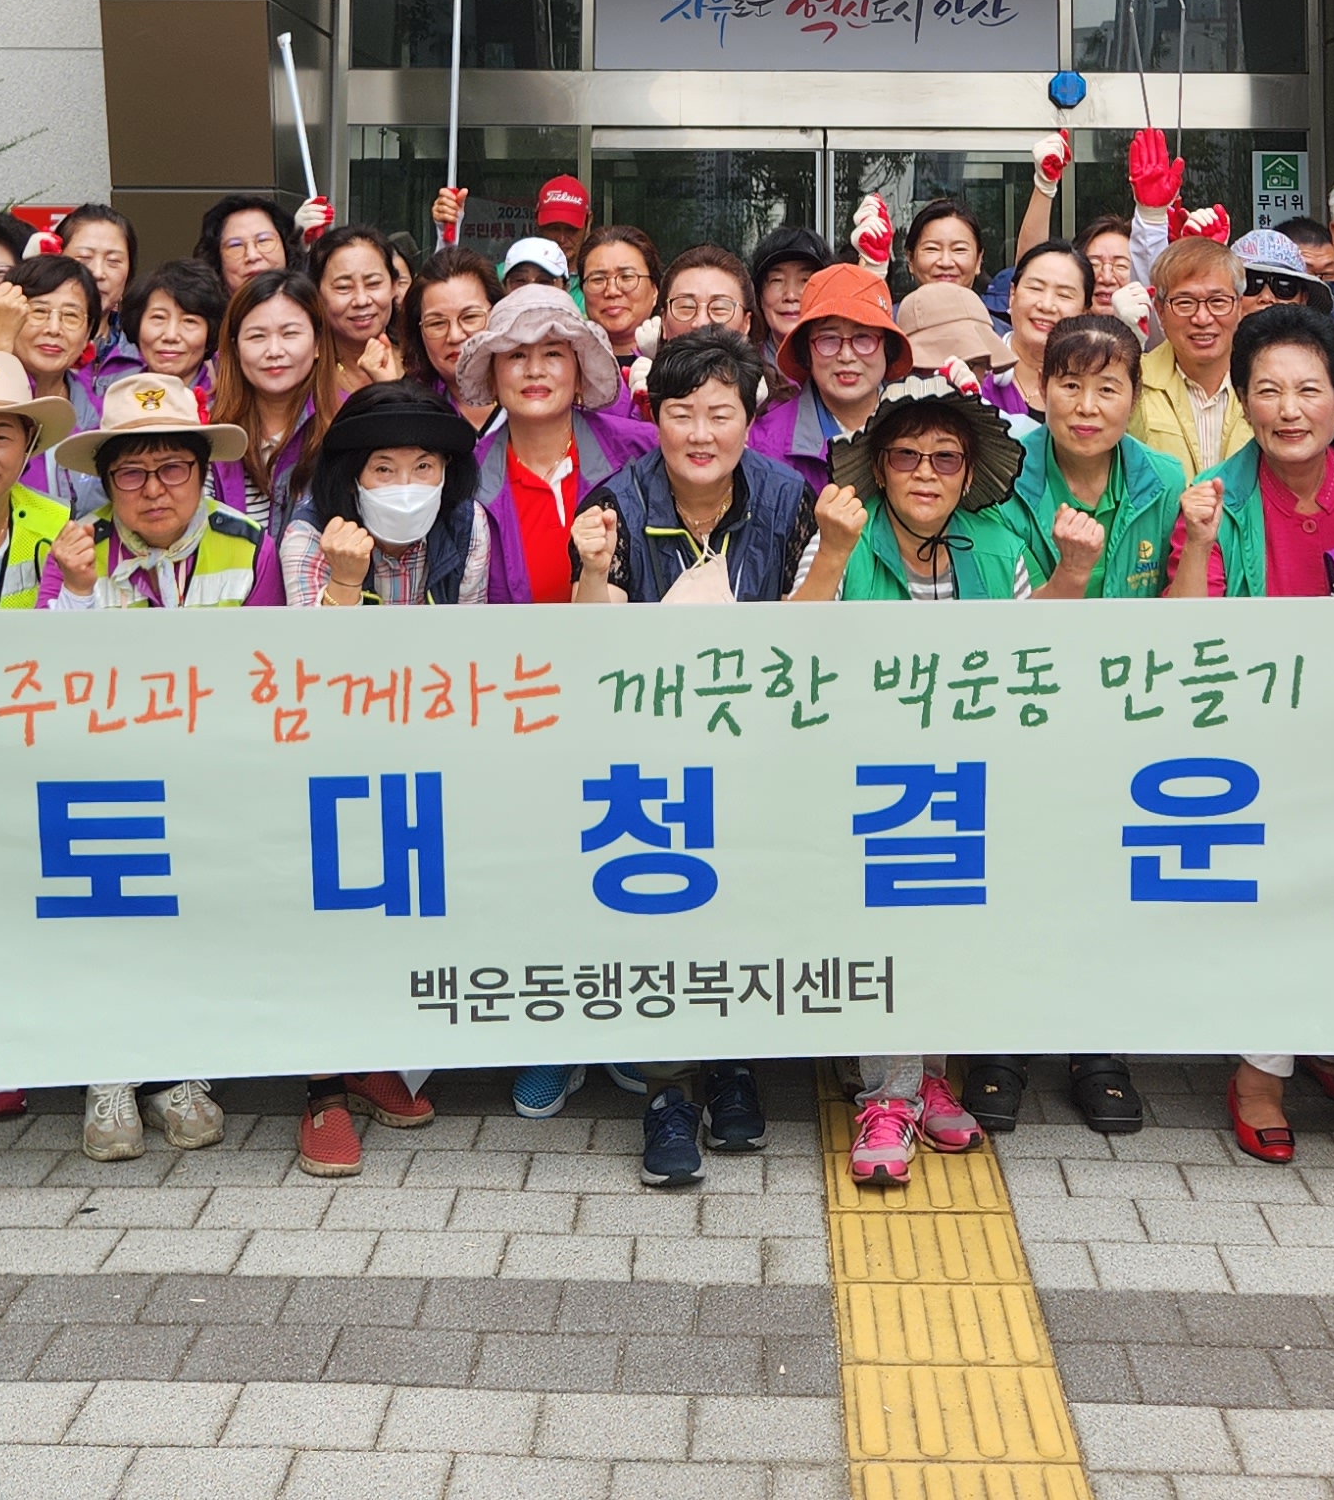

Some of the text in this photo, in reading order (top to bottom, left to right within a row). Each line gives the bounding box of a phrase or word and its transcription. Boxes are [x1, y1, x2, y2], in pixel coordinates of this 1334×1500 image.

[1257, 193, 1304, 211] 무더위
[248, 650, 561, 743] 함께하는
[598, 645, 838, 737] 깨끗한
[873, 646, 1061, 730] 백운동
[1100, 638, 1306, 730] 만들기
[410, 956, 895, 1025] 백운동행정복지센터
